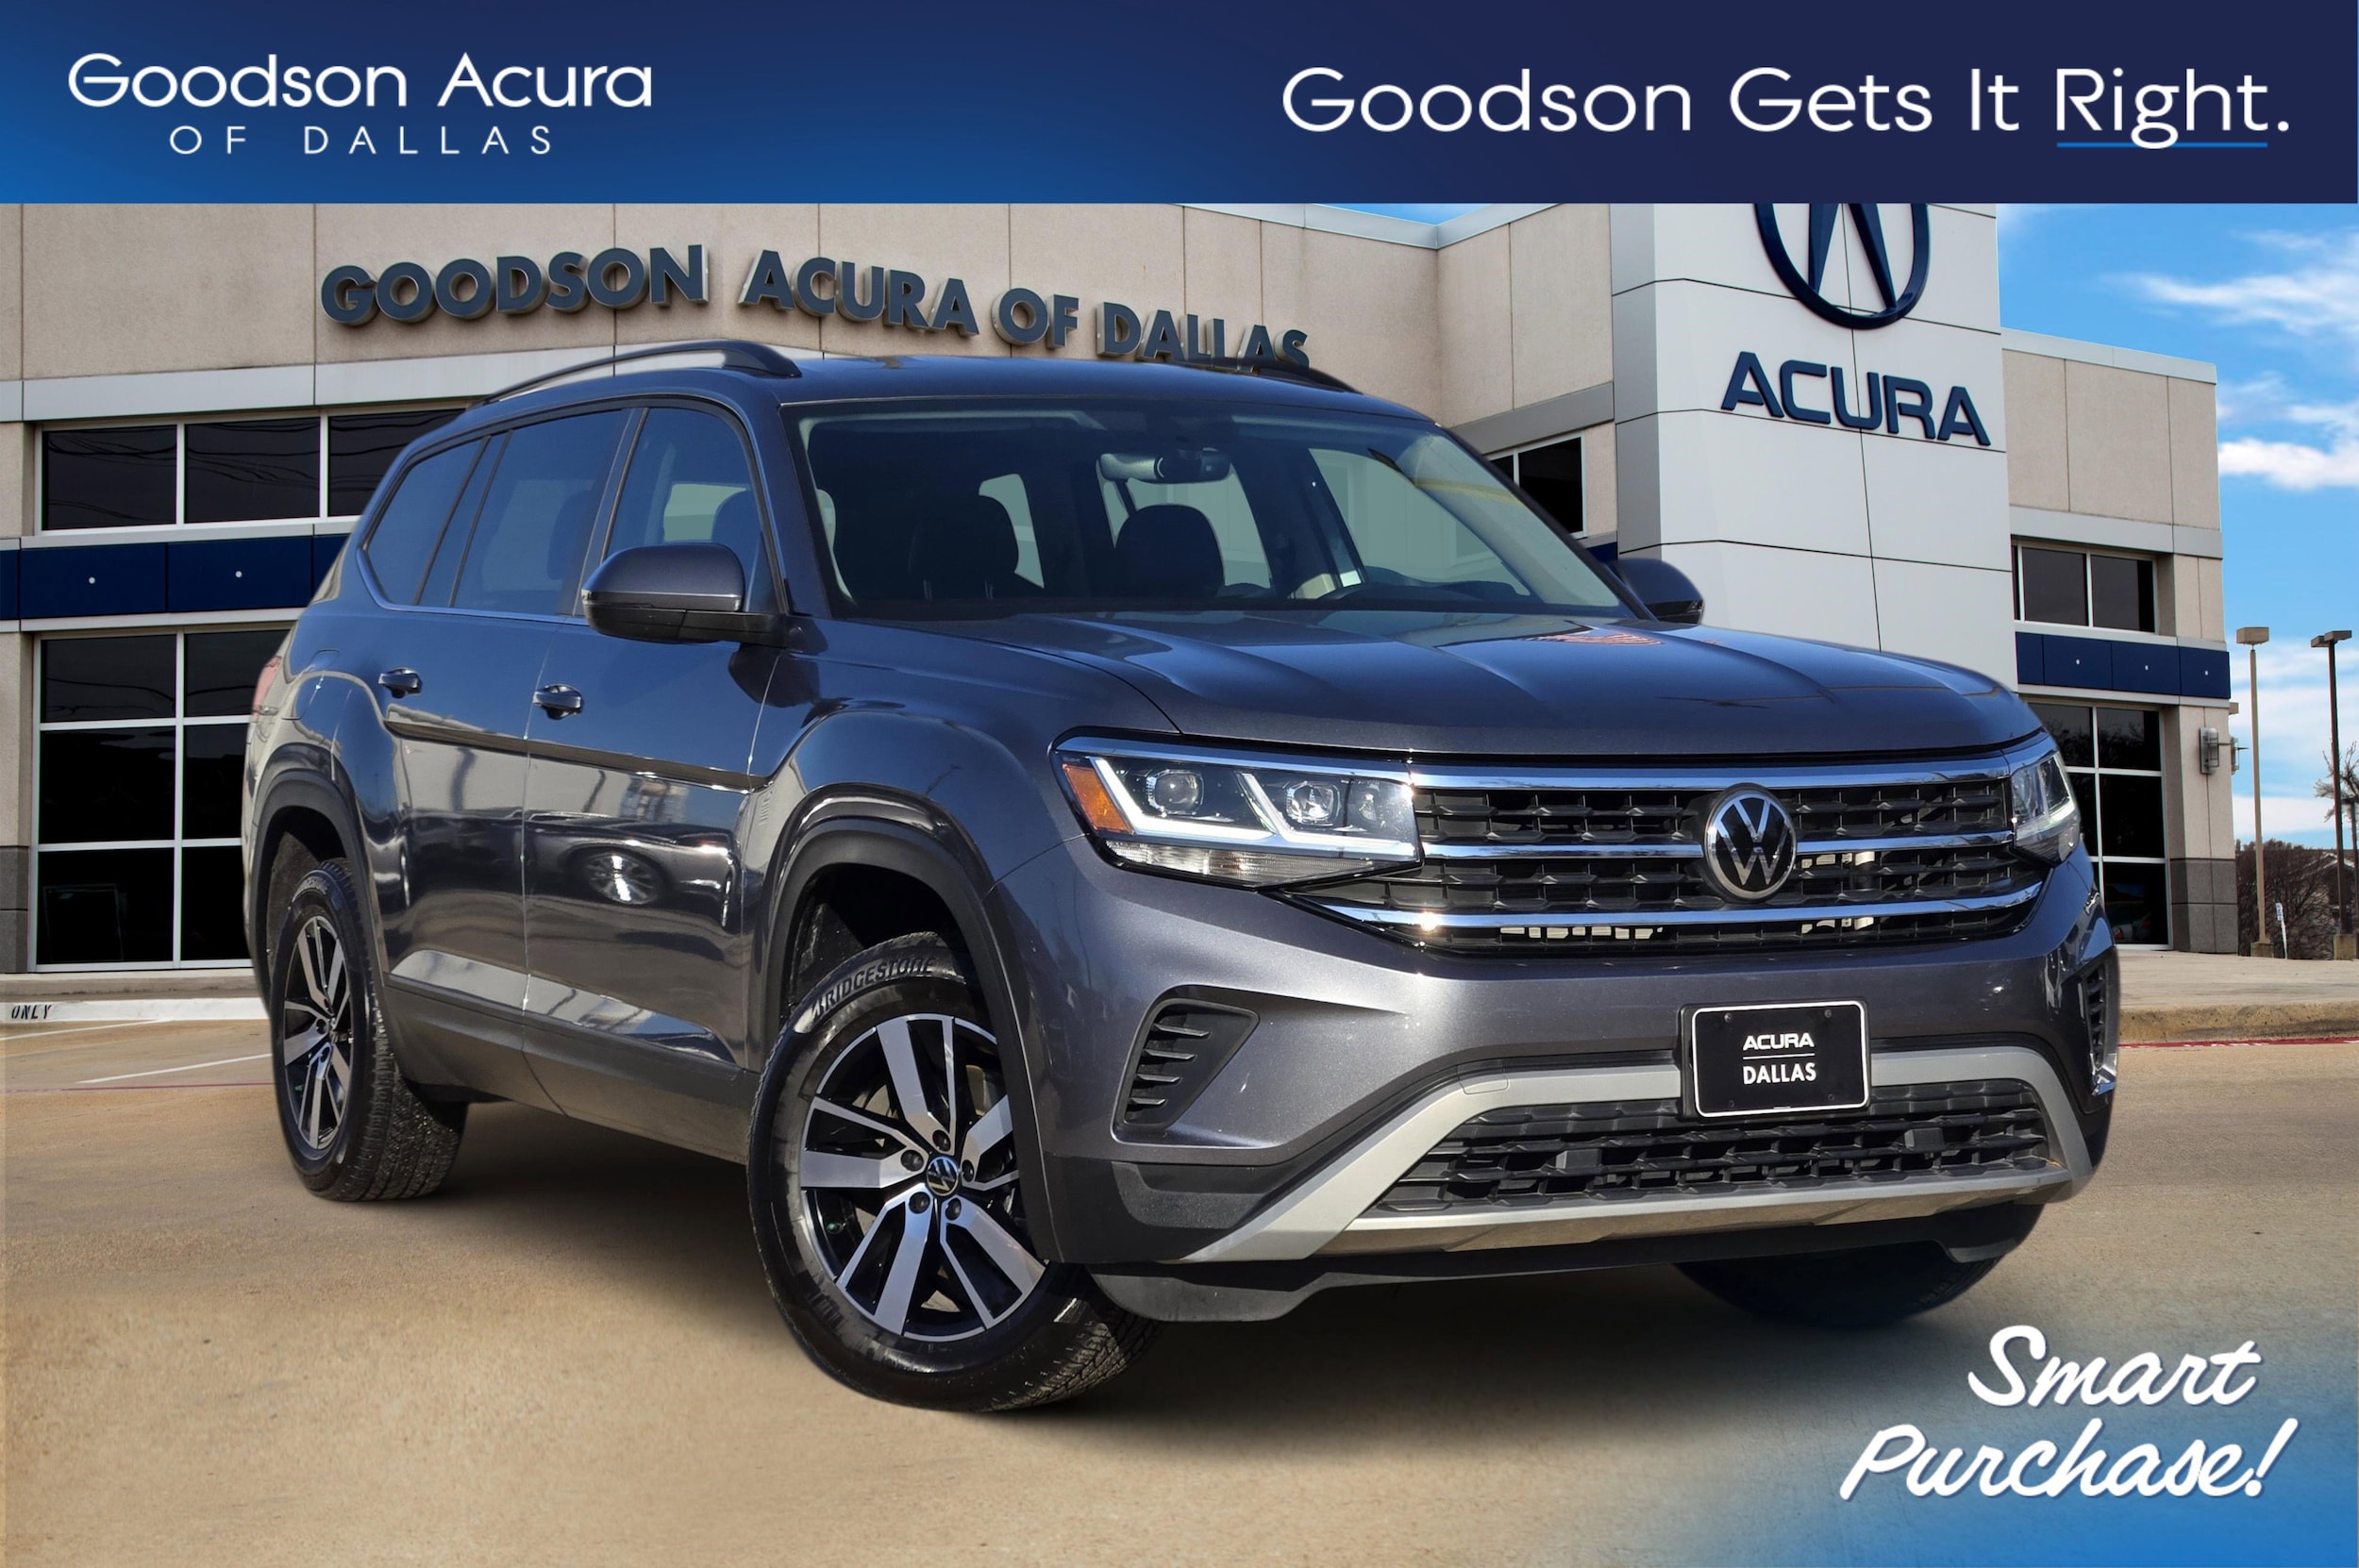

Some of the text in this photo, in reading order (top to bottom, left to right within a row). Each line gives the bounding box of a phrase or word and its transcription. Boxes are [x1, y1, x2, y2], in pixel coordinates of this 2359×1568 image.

[321, 244, 1310, 373] GOODSON ACURA OF DALLAS
[1720, 351, 1991, 446] ACURA
[10, 1004, 52, 1020] ONLY
[1742, 1032, 1815, 1051] ACURA
[1743, 1061, 1817, 1085] DALLAS
